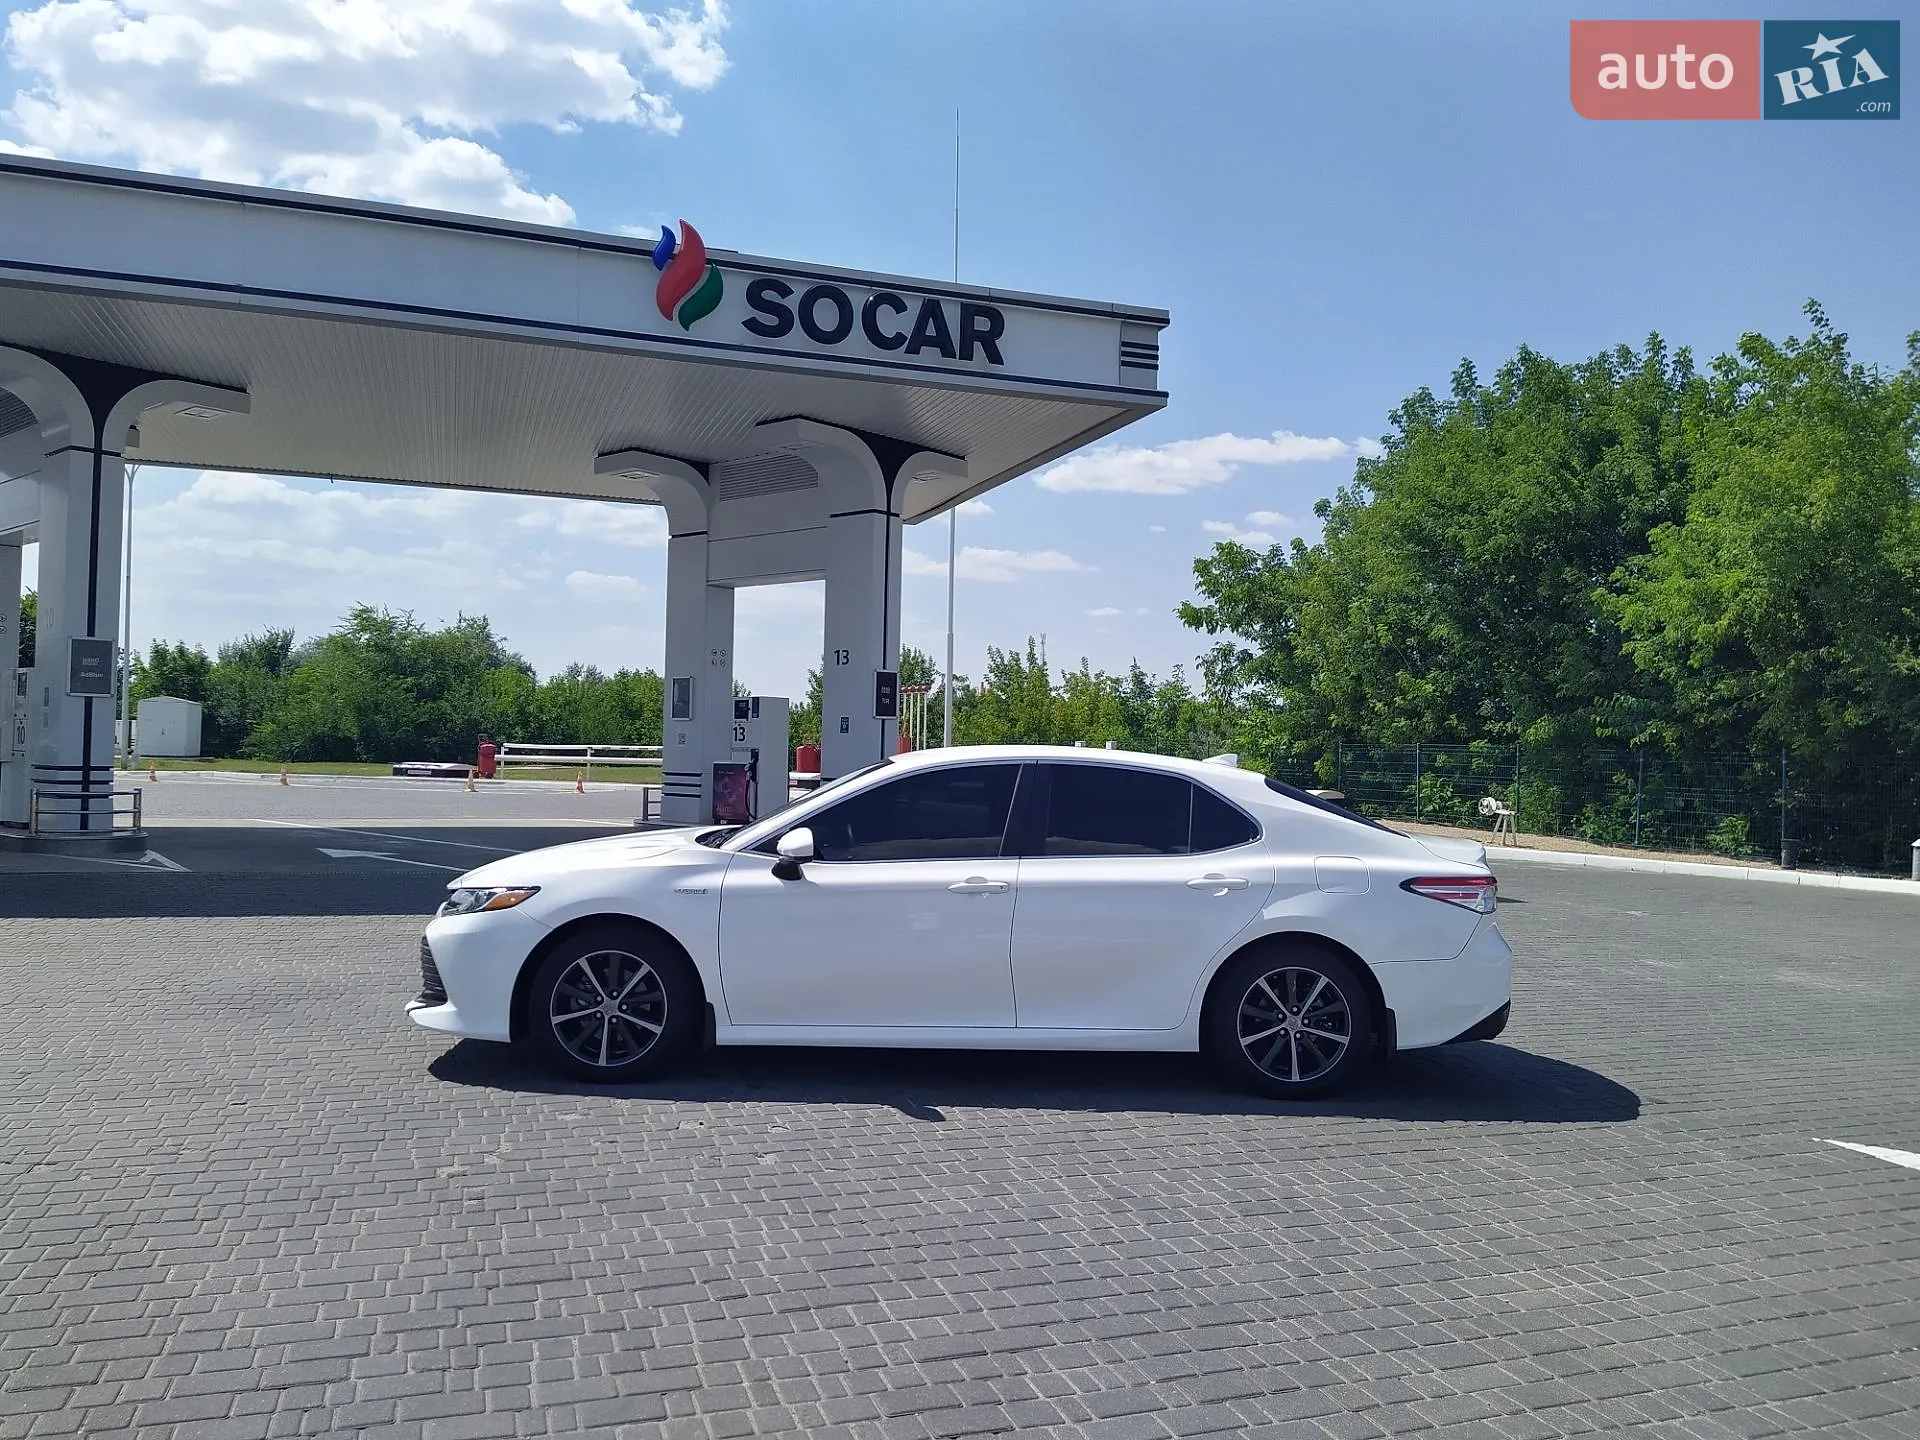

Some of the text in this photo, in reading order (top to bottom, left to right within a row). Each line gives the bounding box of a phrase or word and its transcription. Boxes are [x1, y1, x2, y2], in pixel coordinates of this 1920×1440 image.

[742, 278, 1005, 365] SOCAR
[834, 649, 850, 665] 13
[17, 725, 26, 745] 10
[733, 726, 746, 742] 13
